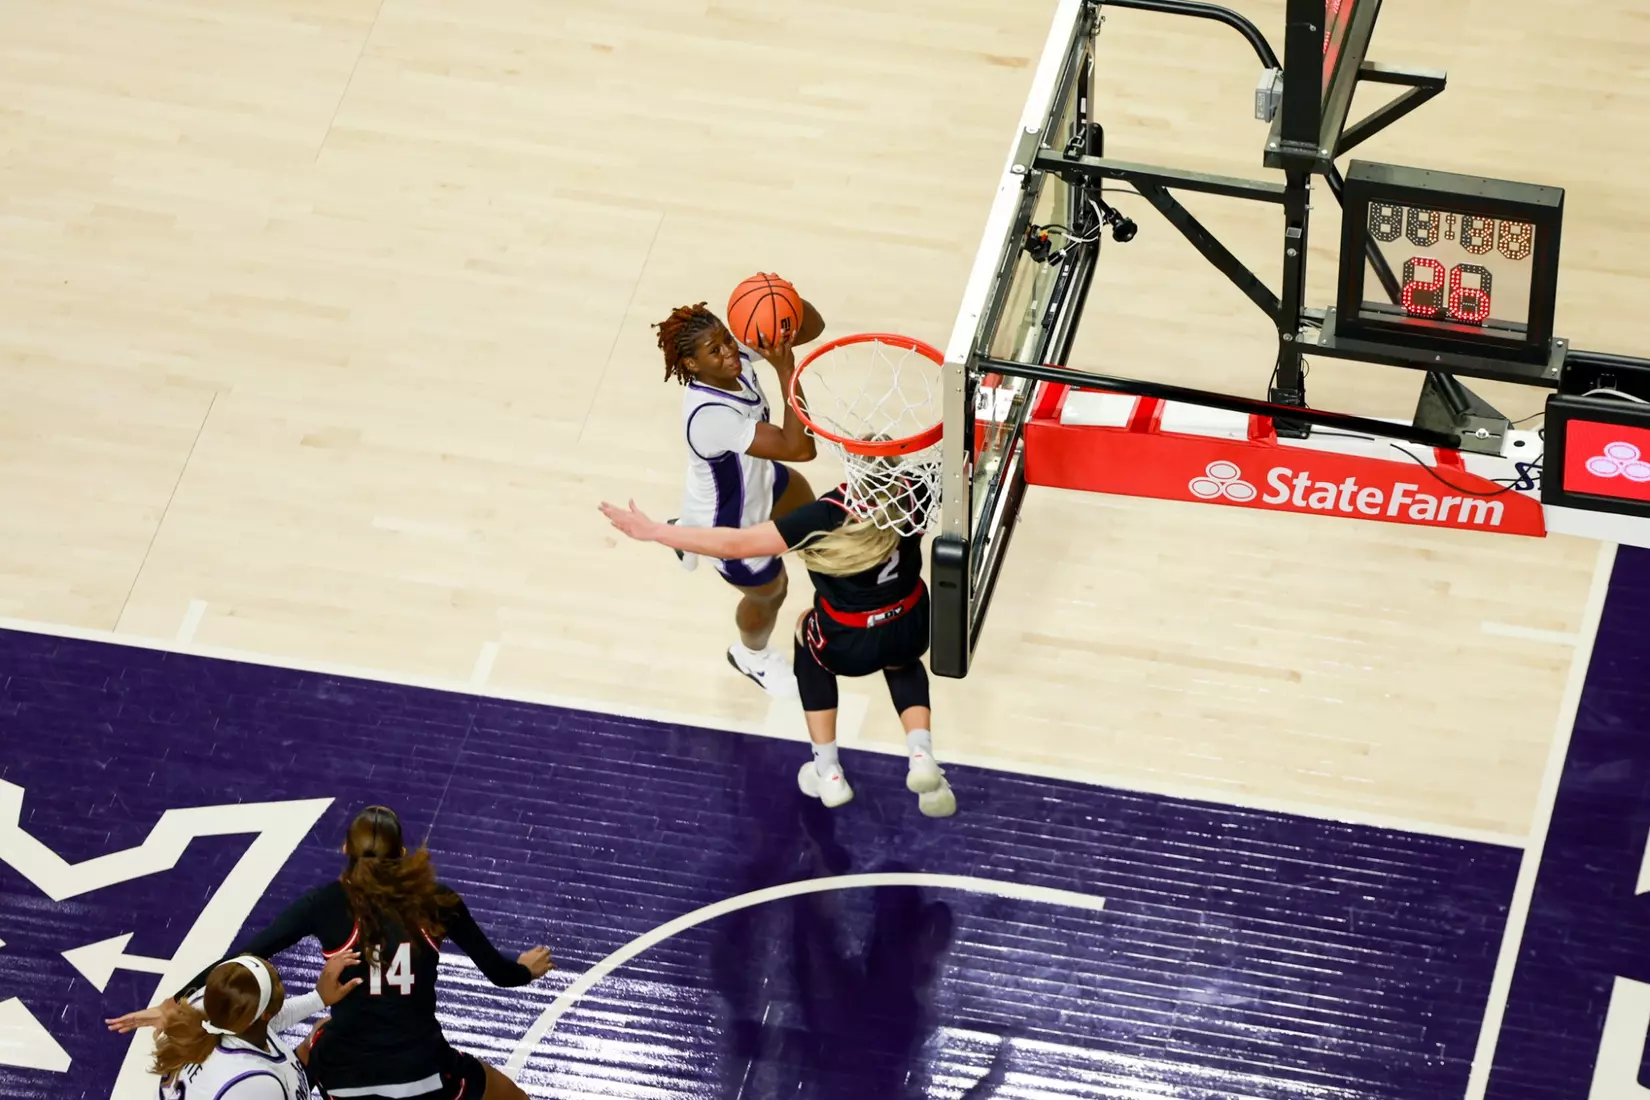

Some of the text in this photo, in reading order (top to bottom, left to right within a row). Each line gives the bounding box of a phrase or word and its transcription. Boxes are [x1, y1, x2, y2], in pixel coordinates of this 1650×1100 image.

[1262, 466, 1504, 526] State Farm
[369, 942, 415, 995] 14
